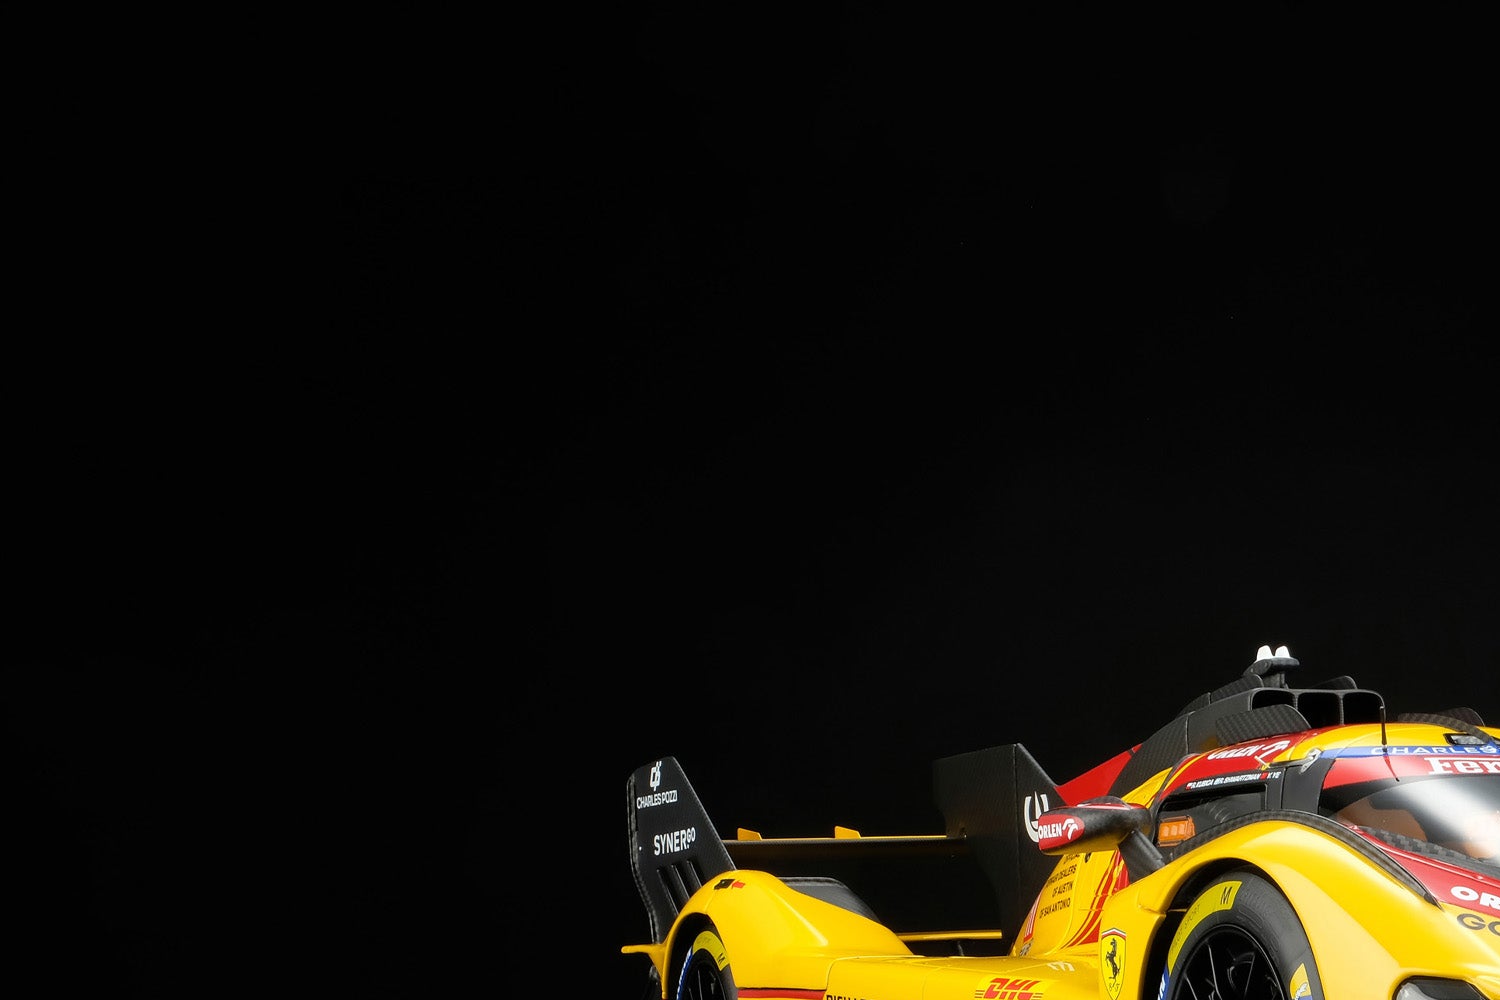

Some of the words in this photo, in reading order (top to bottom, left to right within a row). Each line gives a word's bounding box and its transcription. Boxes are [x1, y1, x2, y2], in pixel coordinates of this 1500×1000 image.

[636, 792, 662, 810] CHARLES
[661, 789, 678, 804] POZZI
[1038, 823, 1062, 839] ORLEN
[983, 977, 1041, 1000] DHL
